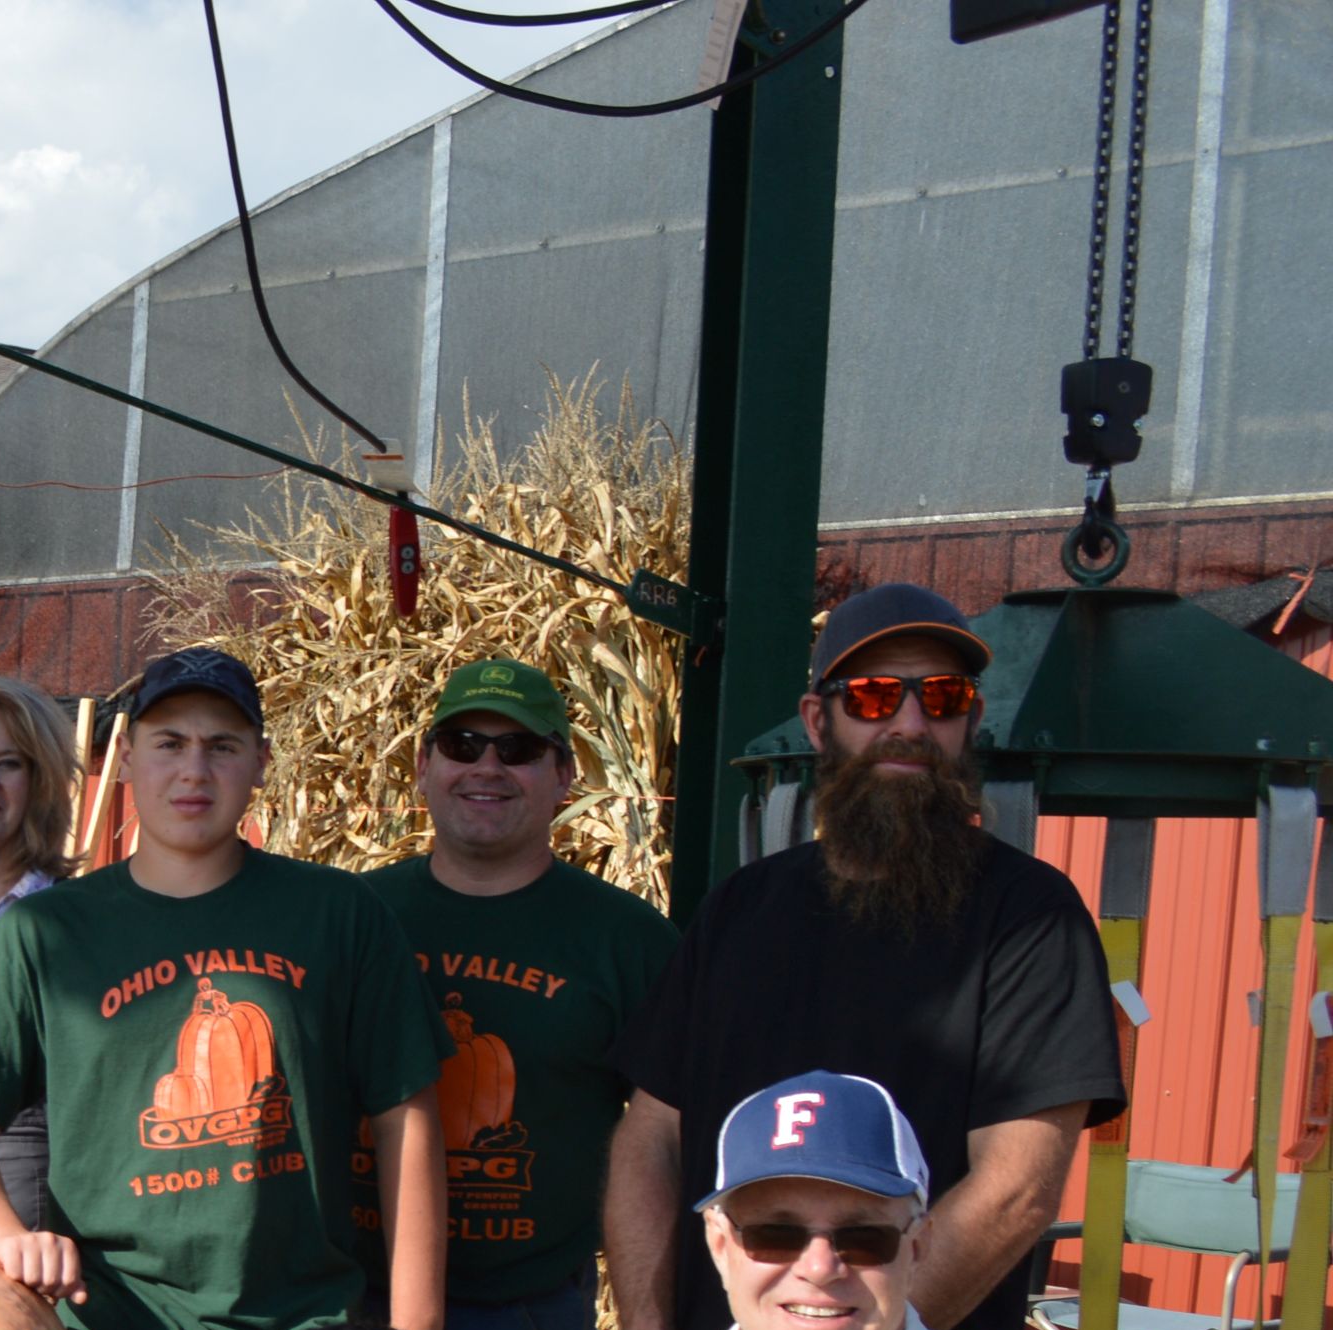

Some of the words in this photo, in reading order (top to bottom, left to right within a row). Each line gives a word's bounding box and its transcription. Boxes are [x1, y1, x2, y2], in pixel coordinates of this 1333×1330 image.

[101, 959, 177, 1019] OHIO
[184, 949, 307, 990] VALLEY
[441, 952, 567, 999] VALLEY
[149, 1102, 284, 1145] OVGPG
[771, 1092, 825, 1151] F
[129, 1167, 221, 1197] 1500#
[232, 1152, 307, 1183] CLUB
